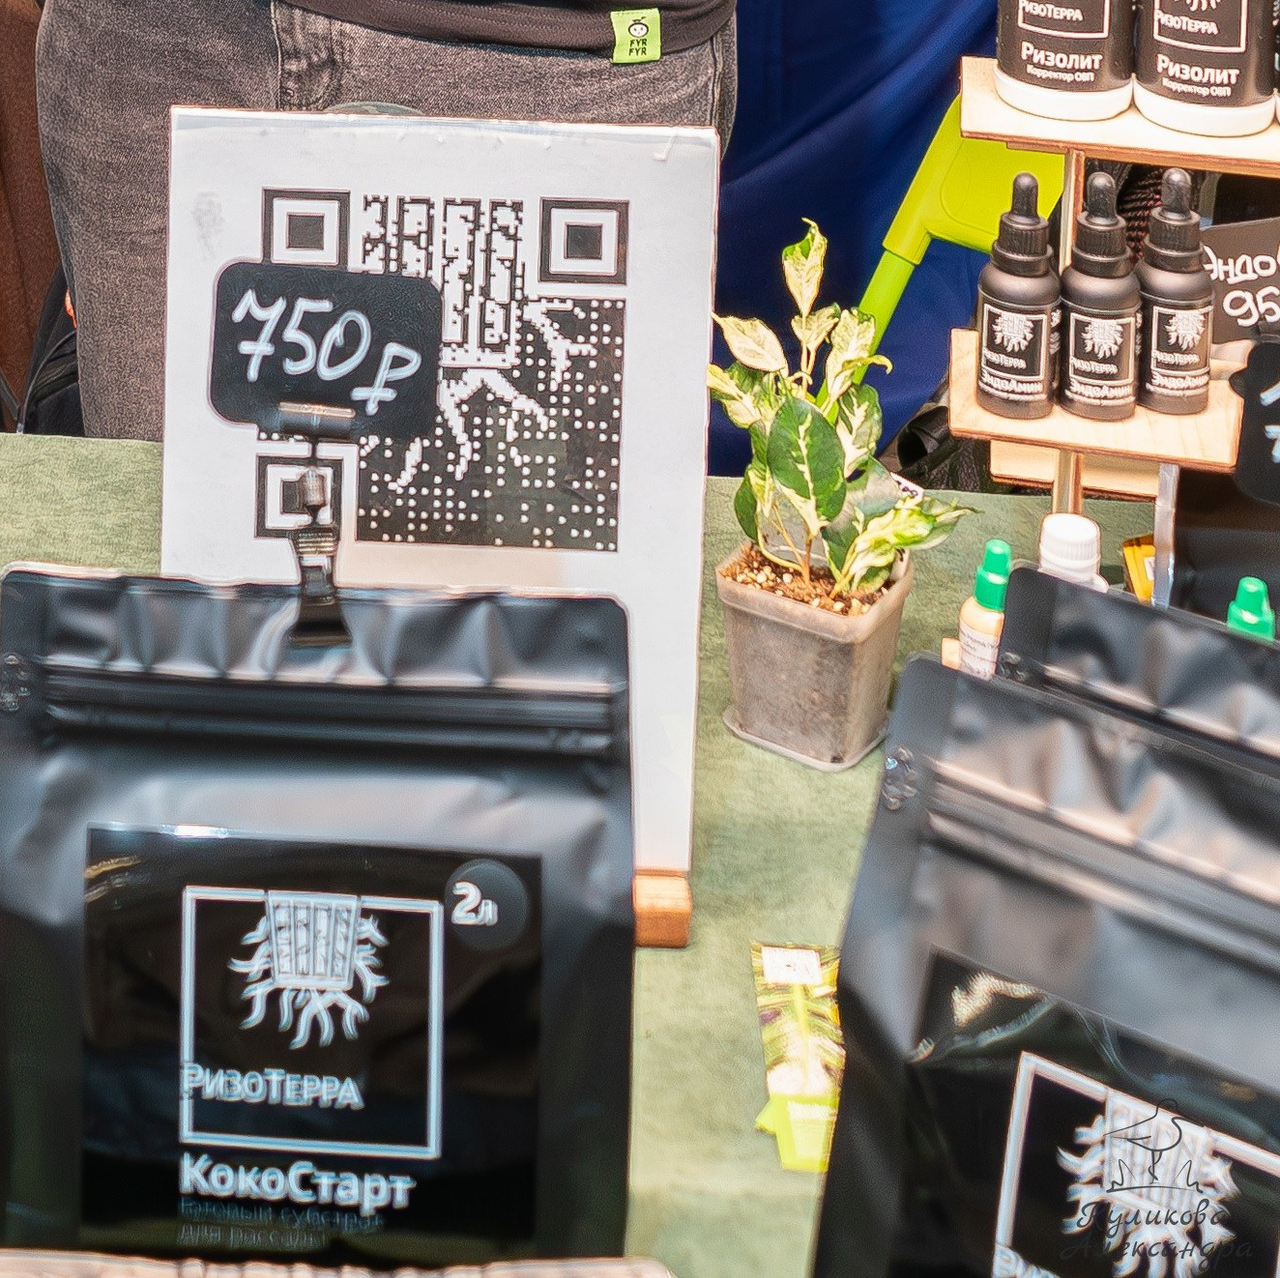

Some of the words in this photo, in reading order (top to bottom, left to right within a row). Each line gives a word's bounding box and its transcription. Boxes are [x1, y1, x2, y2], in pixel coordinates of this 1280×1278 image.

[628, 47, 648, 57] FYR
[629, 38, 648, 47] FYR
[450, 879, 500, 928] 2л
[179, 1151, 418, 1218] КокоСтарт
